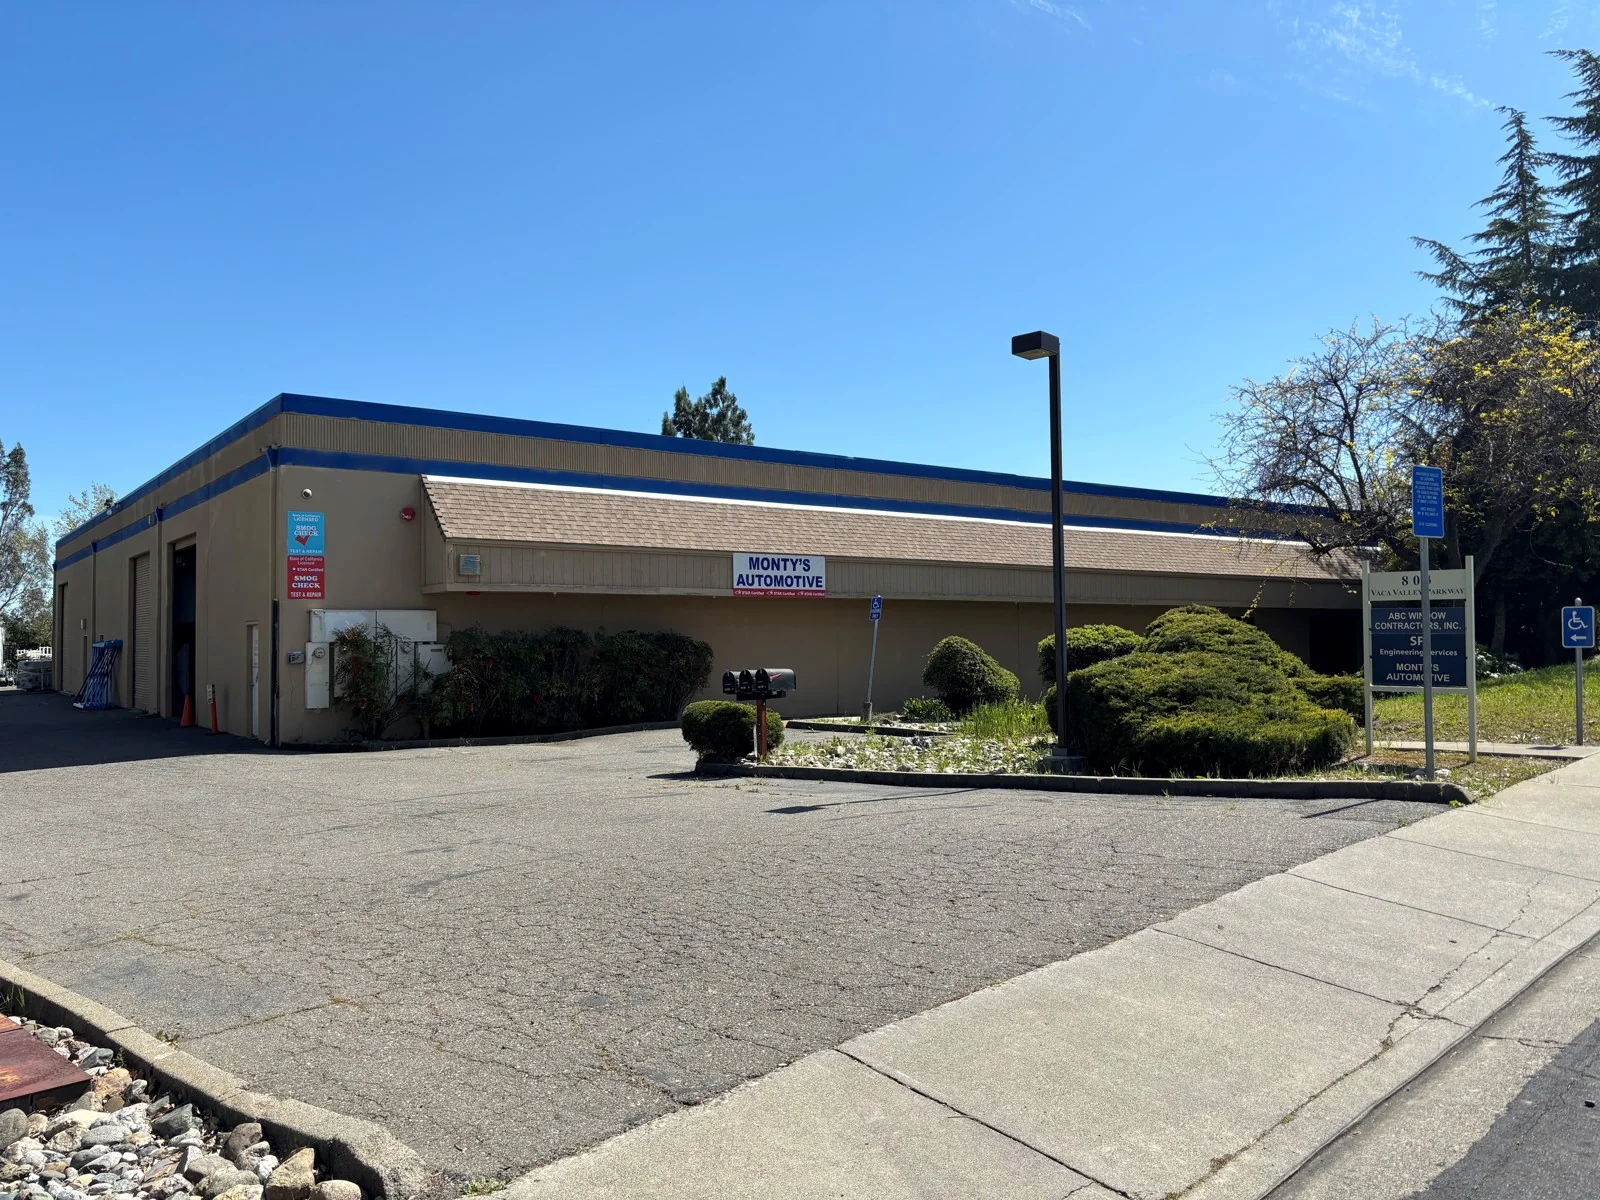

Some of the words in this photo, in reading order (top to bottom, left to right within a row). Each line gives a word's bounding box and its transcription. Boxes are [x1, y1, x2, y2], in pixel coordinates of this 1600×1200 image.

[748, 556, 811, 572] MONTY'S
[736, 573, 823, 588] AUTOMOTIVE
[1371, 589, 1392, 597] VACA
[1388, 612, 1406, 620] ABC
[1443, 621, 1461, 630] INC.
[1379, 648, 1424, 657] Engineering
[1430, 648, 1458, 656] ervices
